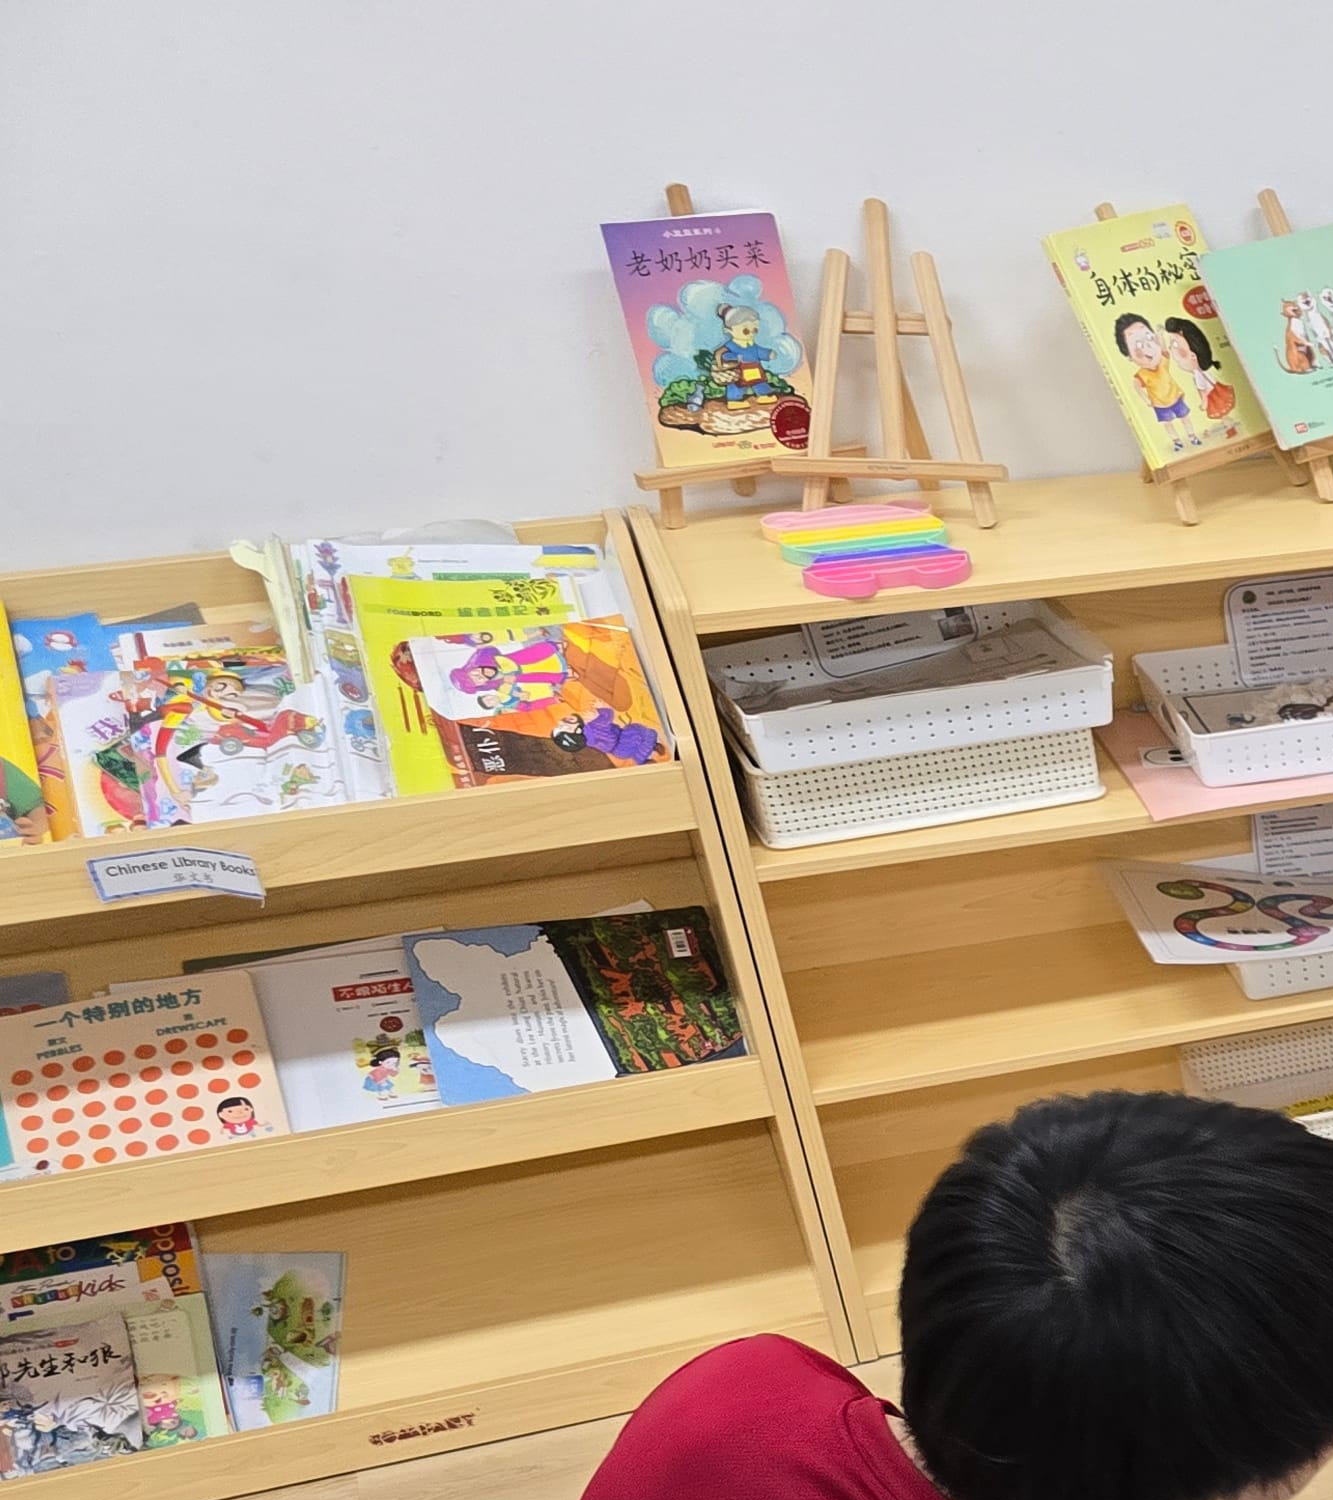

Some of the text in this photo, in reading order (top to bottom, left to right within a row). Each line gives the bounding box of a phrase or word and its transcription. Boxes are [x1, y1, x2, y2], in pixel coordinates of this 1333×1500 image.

[625, 239, 771, 277] 老奶奶买菜
[1090, 247, 1202, 306] 身体的秘密
[105, 856, 257, 878] Chinese Library Books
[33, 988, 203, 1028] 一个特别的地方
[155, 1017, 228, 1037] DREWSCAPE
